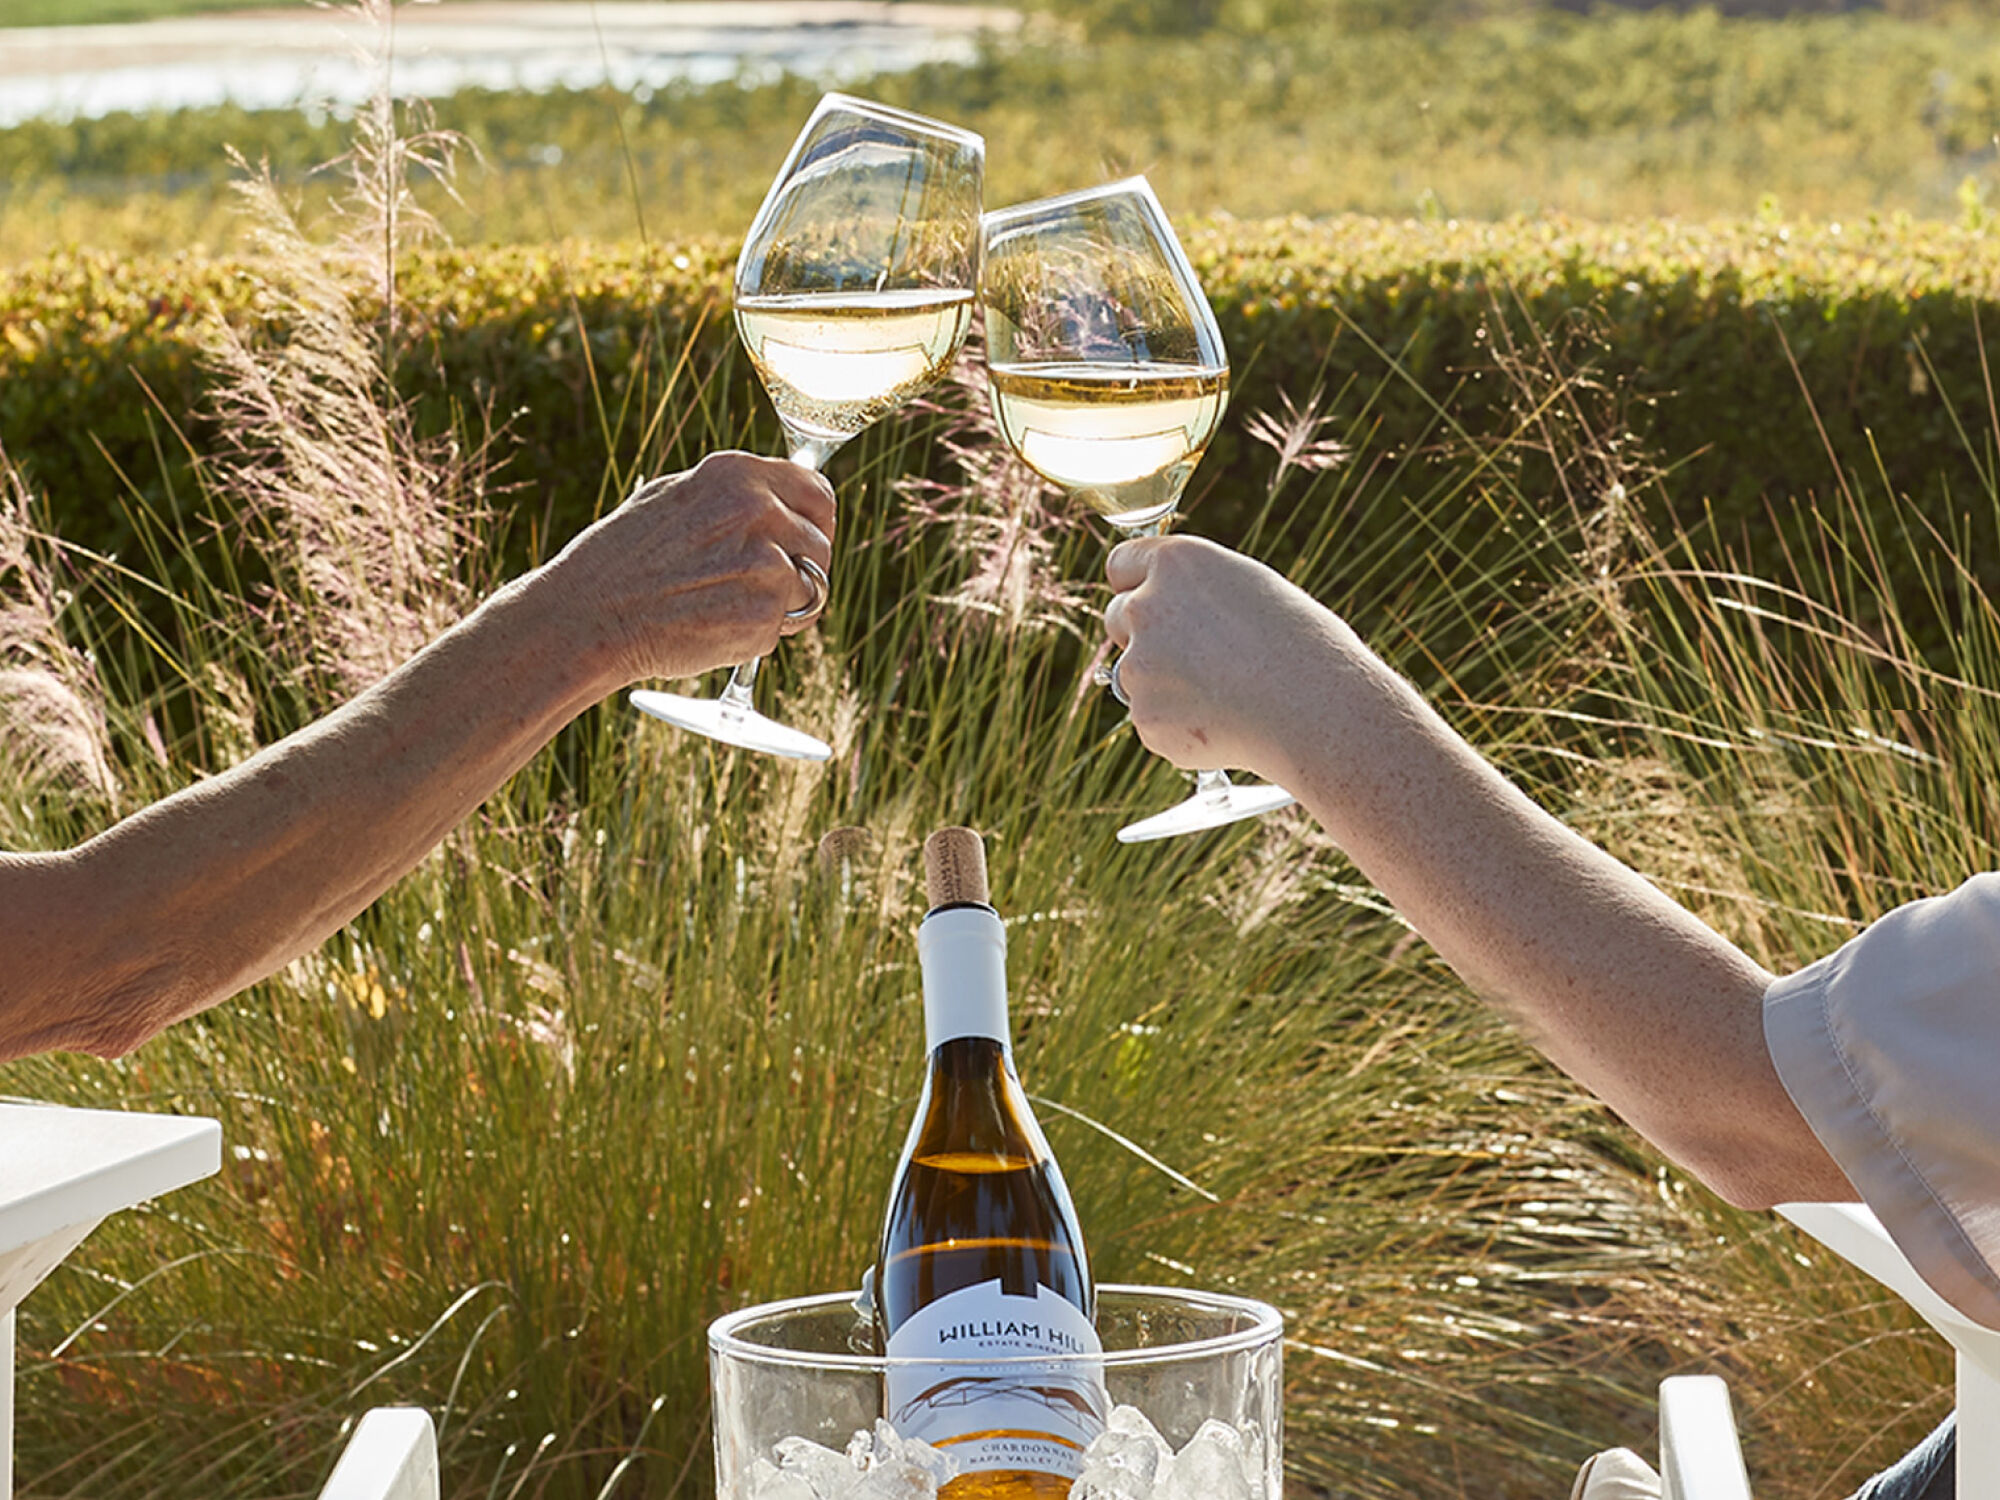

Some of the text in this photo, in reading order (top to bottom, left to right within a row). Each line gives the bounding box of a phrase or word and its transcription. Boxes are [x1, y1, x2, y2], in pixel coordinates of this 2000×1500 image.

[939, 1321, 1085, 1354] WILLIAM HILL
[978, 1340, 1020, 1348] ESTATE
[981, 1443, 1075, 1461] CHARDONNAY
[969, 1455, 1001, 1464] NAPA
[1008, 1455, 1052, 1465] VALLEY
